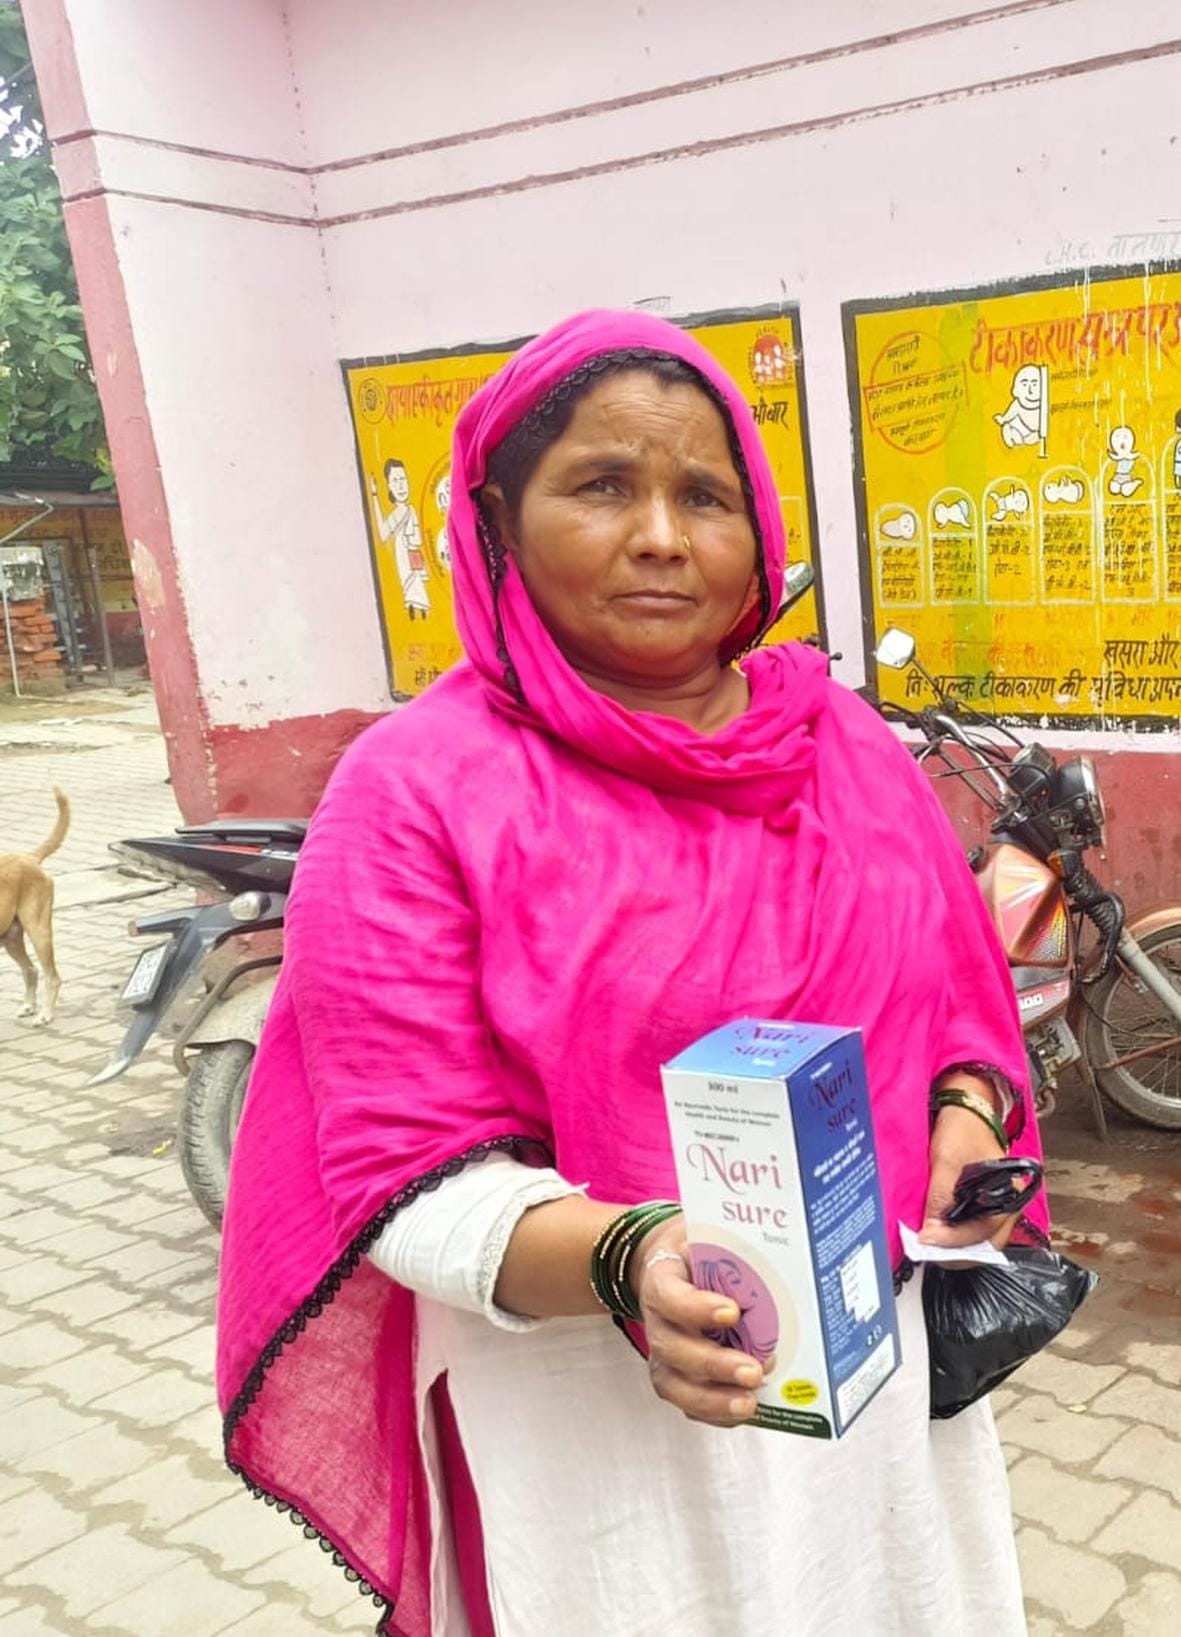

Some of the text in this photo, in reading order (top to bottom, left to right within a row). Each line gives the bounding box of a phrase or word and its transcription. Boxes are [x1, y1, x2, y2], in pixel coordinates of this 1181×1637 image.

[1148, 632, 1180, 669] और
[980, 671, 1056, 700] टीकाकरण
[1059, 668, 1087, 697] की
[686, 1143, 783, 1196] Nari
[721, 1200, 790, 1229] sure
